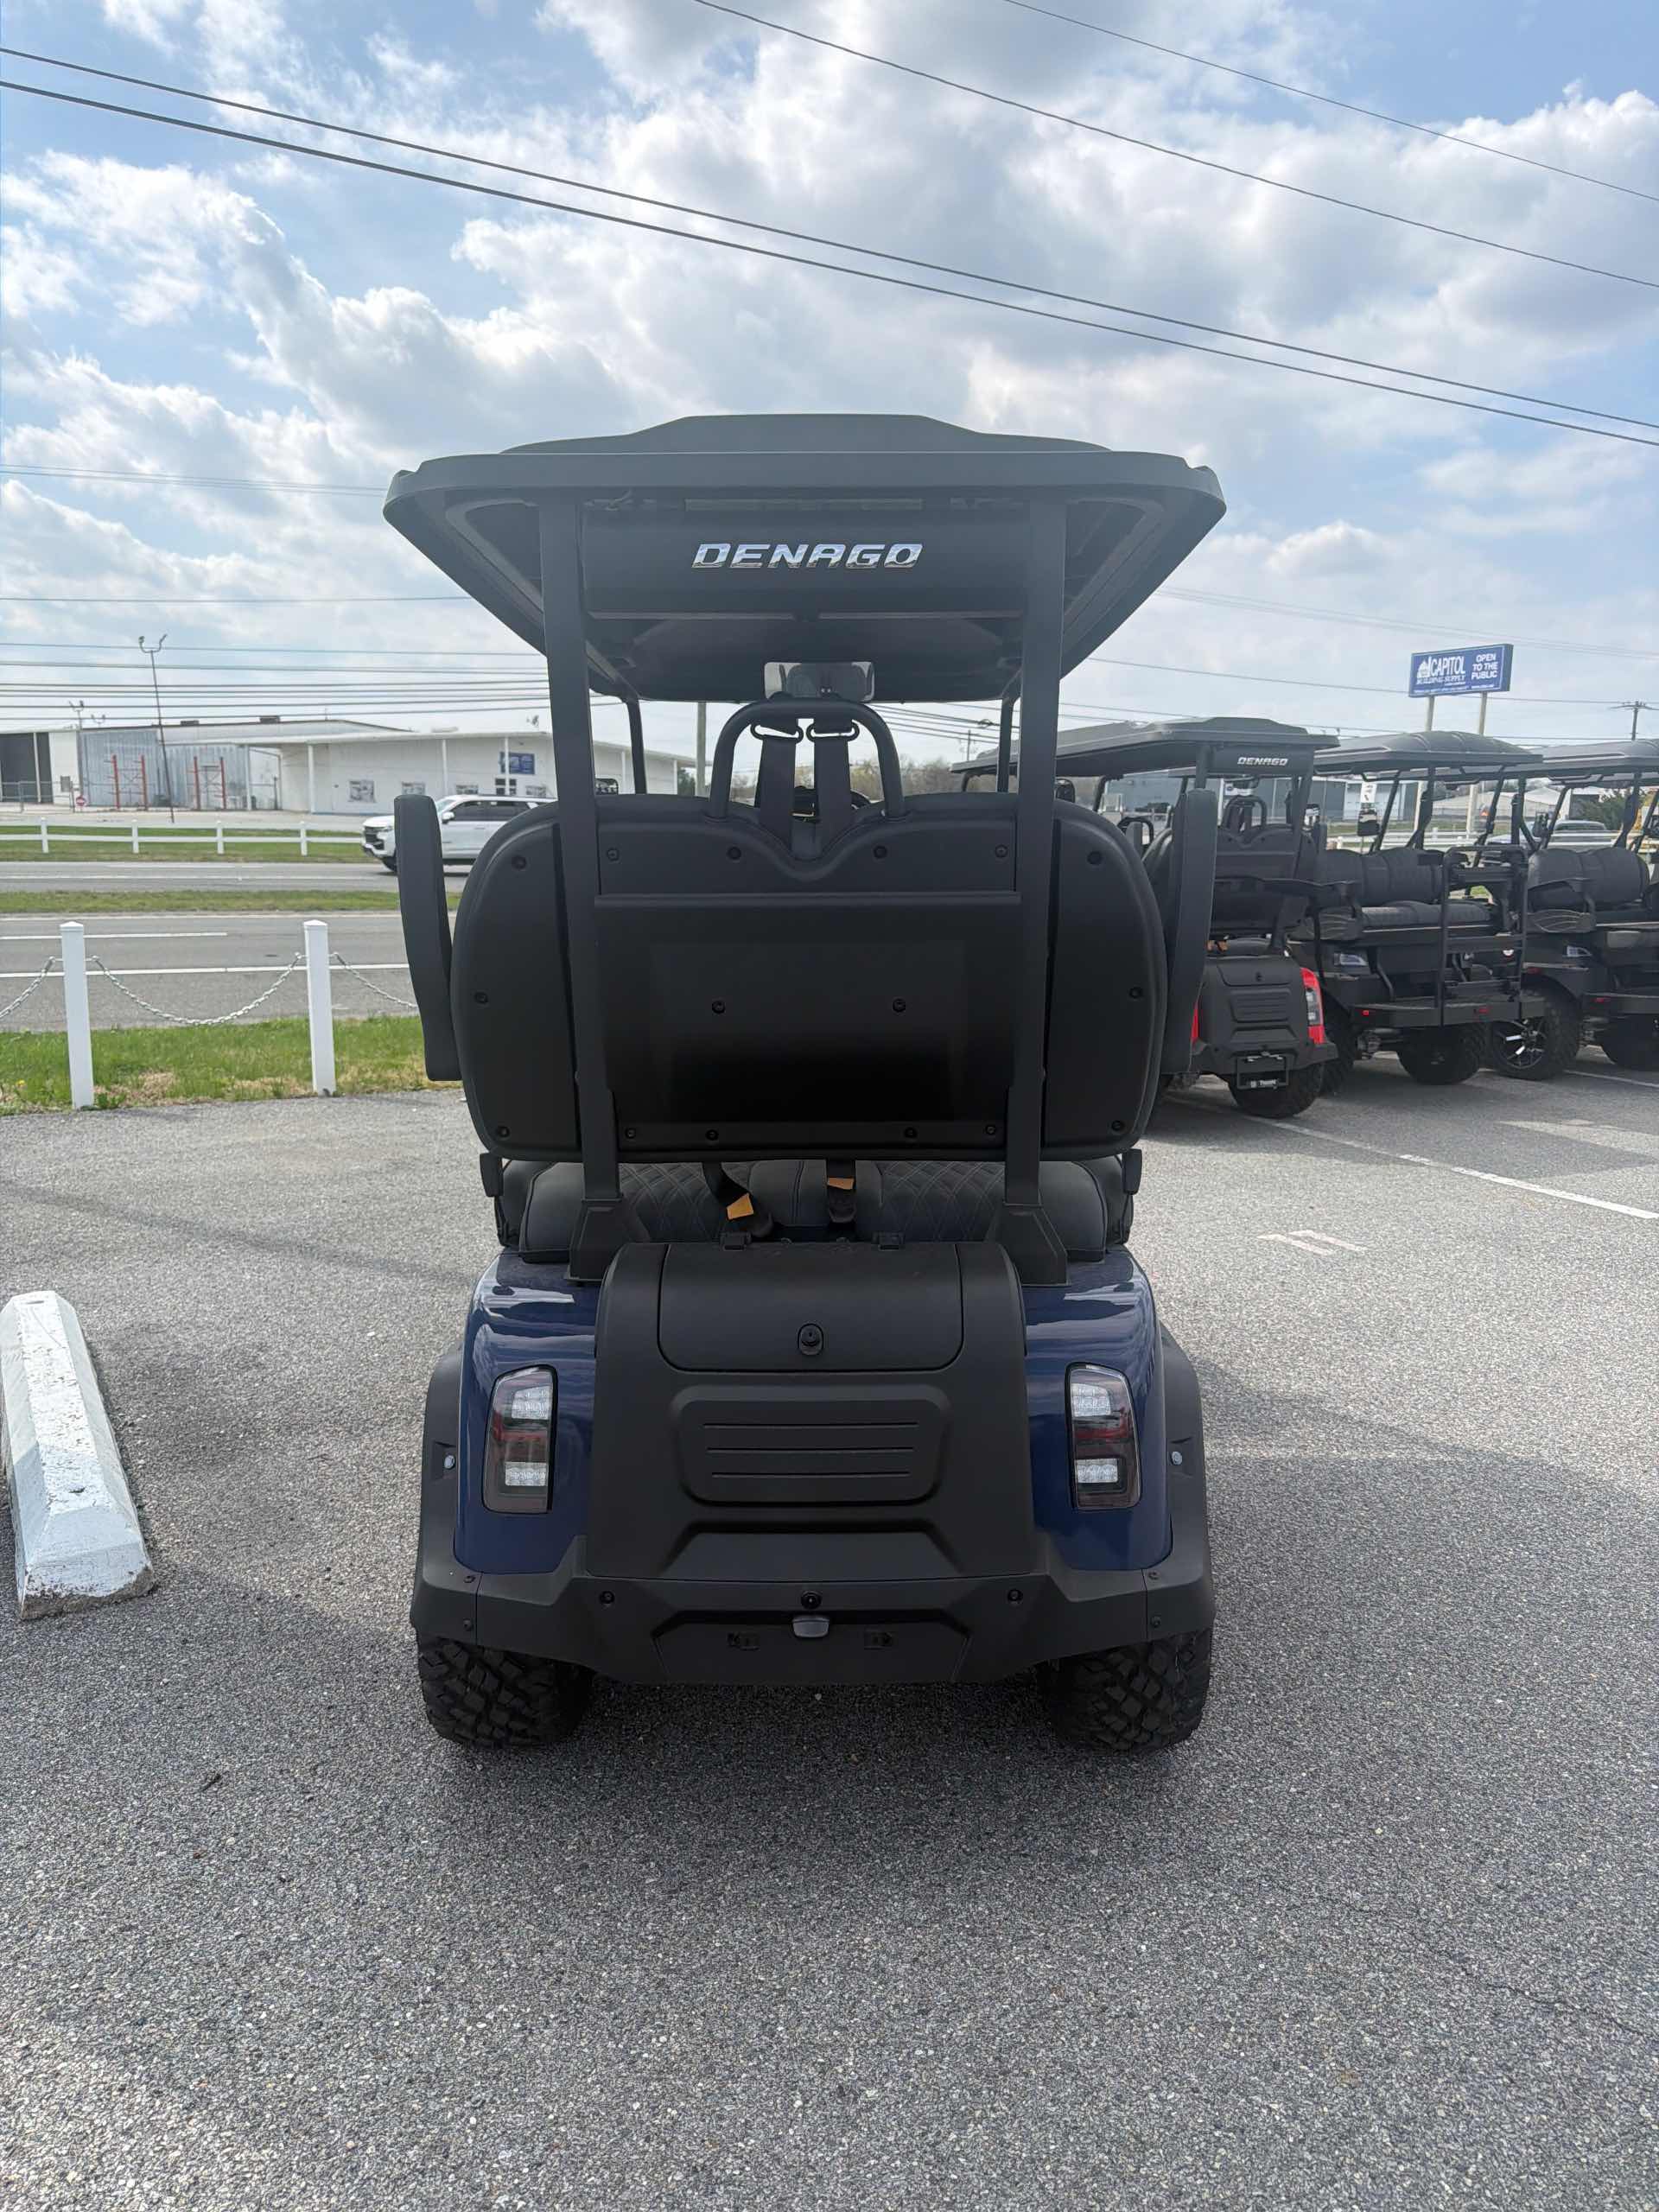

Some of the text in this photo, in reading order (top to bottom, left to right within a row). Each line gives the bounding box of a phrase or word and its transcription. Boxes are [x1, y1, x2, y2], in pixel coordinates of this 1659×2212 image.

[691, 543, 923, 569] DENAGO
[1476, 653, 1497, 663] OPEN
[1431, 656, 1465, 676] CAPITOL
[1484, 662, 1498, 671] THE
[1471, 671, 1497, 680] PUBLIC
[1237, 756, 1288, 766] DENAGO
